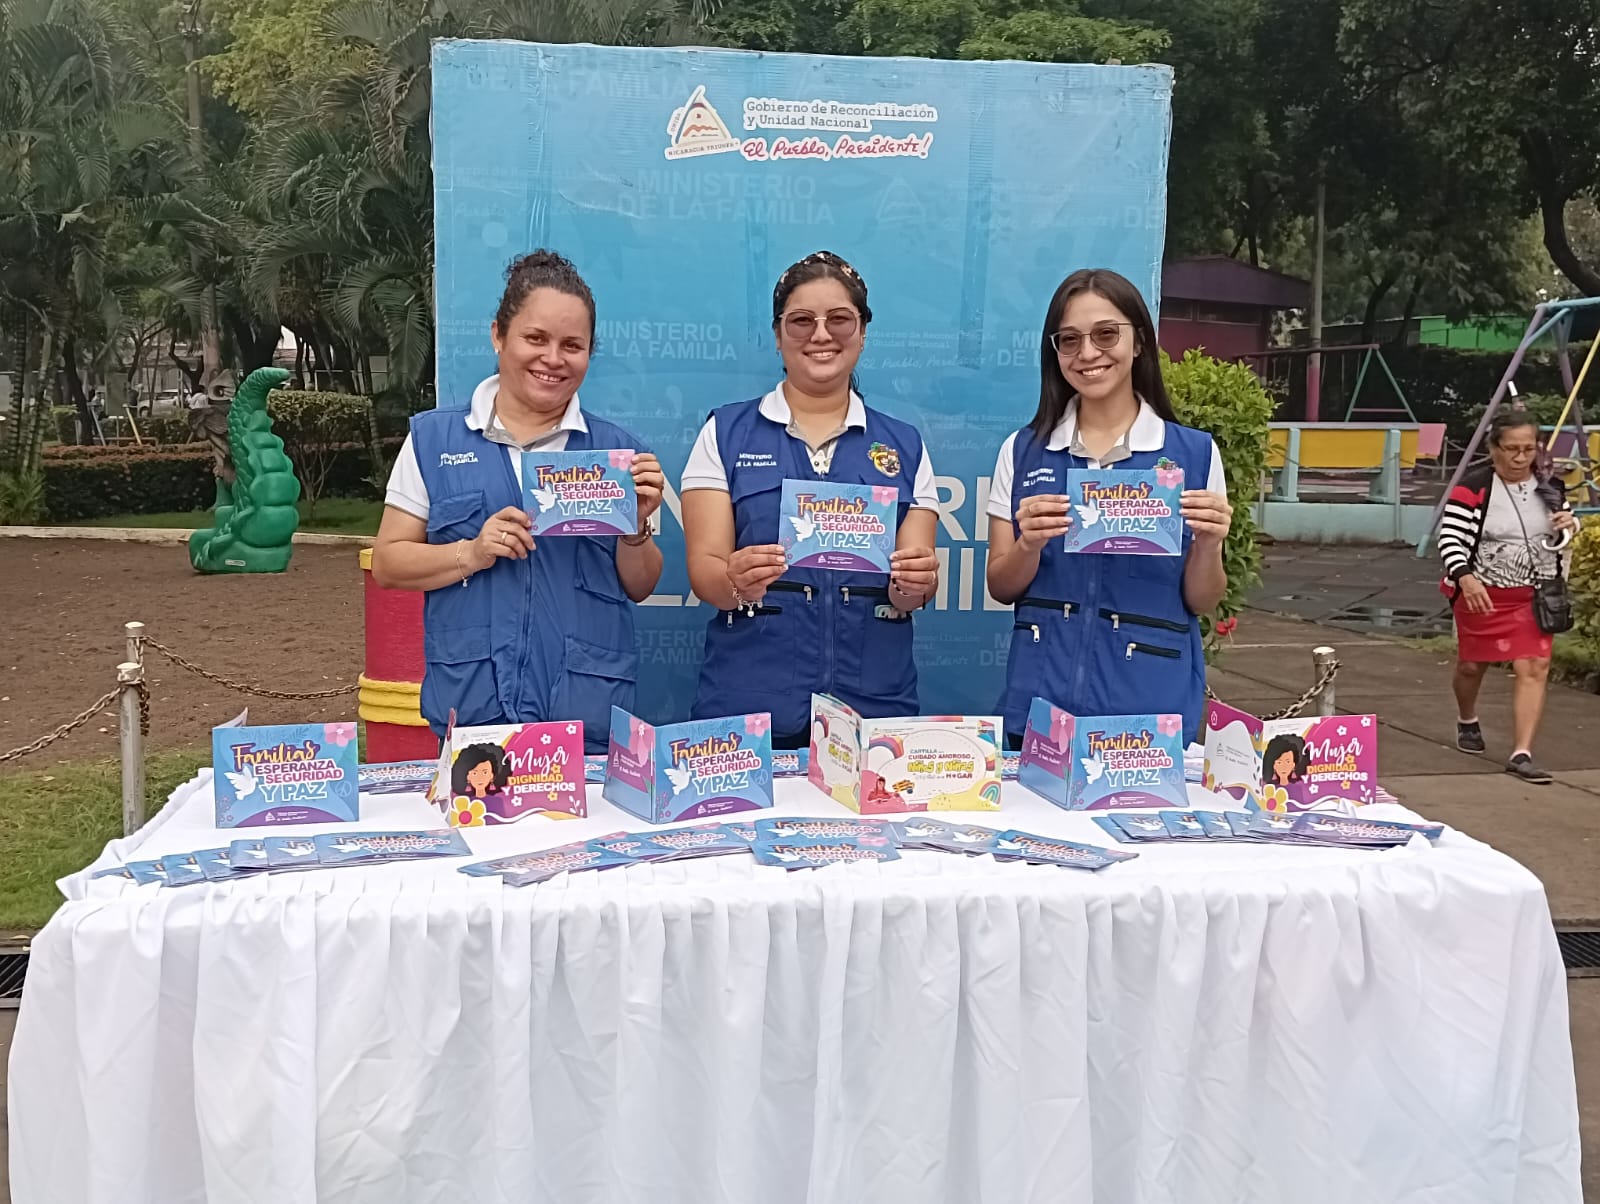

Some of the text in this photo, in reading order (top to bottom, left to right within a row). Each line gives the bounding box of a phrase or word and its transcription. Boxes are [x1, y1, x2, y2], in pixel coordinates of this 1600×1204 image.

[746, 101, 934, 118] Gobierno de Reconciliación
[747, 115, 869, 129] y Unidad Nacional
[743, 136, 930, 157] El Pueblo, Presidente!
[638, 170, 816, 200] MINISTERIO
[717, 199, 835, 224] FAMILIA
[612, 340, 641, 358] LA
[648, 340, 737, 361] FAMILIA
[997, 348, 1027, 367] DE
[535, 464, 606, 489] Familias
[554, 481, 618, 493] ESPERANZA
[562, 489, 624, 500] SEGURIDAD
[1080, 481, 1153, 504] Familias
[558, 499, 612, 515] Y PAZ
[796, 494, 868, 517] Familias
[1099, 499, 1164, 509] ESPERANZA
[1106, 507, 1170, 517] SEGURIDAD
[813, 513, 878, 524] ESPERANZA
[1101, 516, 1156, 532] Y PAZ
[821, 522, 884, 533] SEGURIDAD
[816, 531, 870, 548] Y PAZ
[669, 732, 742, 766] Familias
[1087, 729, 1154, 757] Familias
[231, 740, 321, 772] Familias
[688, 750, 755, 769] ESPERANZA
[1102, 748, 1166, 761] ESPERANZA
[1302, 738, 1364, 766] Mujer
[255, 760, 336, 775] ESPERANZA
[502, 746, 570, 777] Mujer
[697, 758, 761, 777] SEGURIDAD
[1110, 757, 1172, 770] SEGURIDAD
[1306, 763, 1357, 774] DIGNIDAD
[265, 769, 342, 784] SEGURIDAD
[507, 773, 564, 785] DIGNIDAD
[693, 771, 749, 795] Y PAZ
[1105, 768, 1160, 787] Y PAZ
[1301, 771, 1368, 784] Y DERECHOS
[259, 781, 327, 802] Y PAZ
[502, 782, 576, 796] Y DERECHOS
